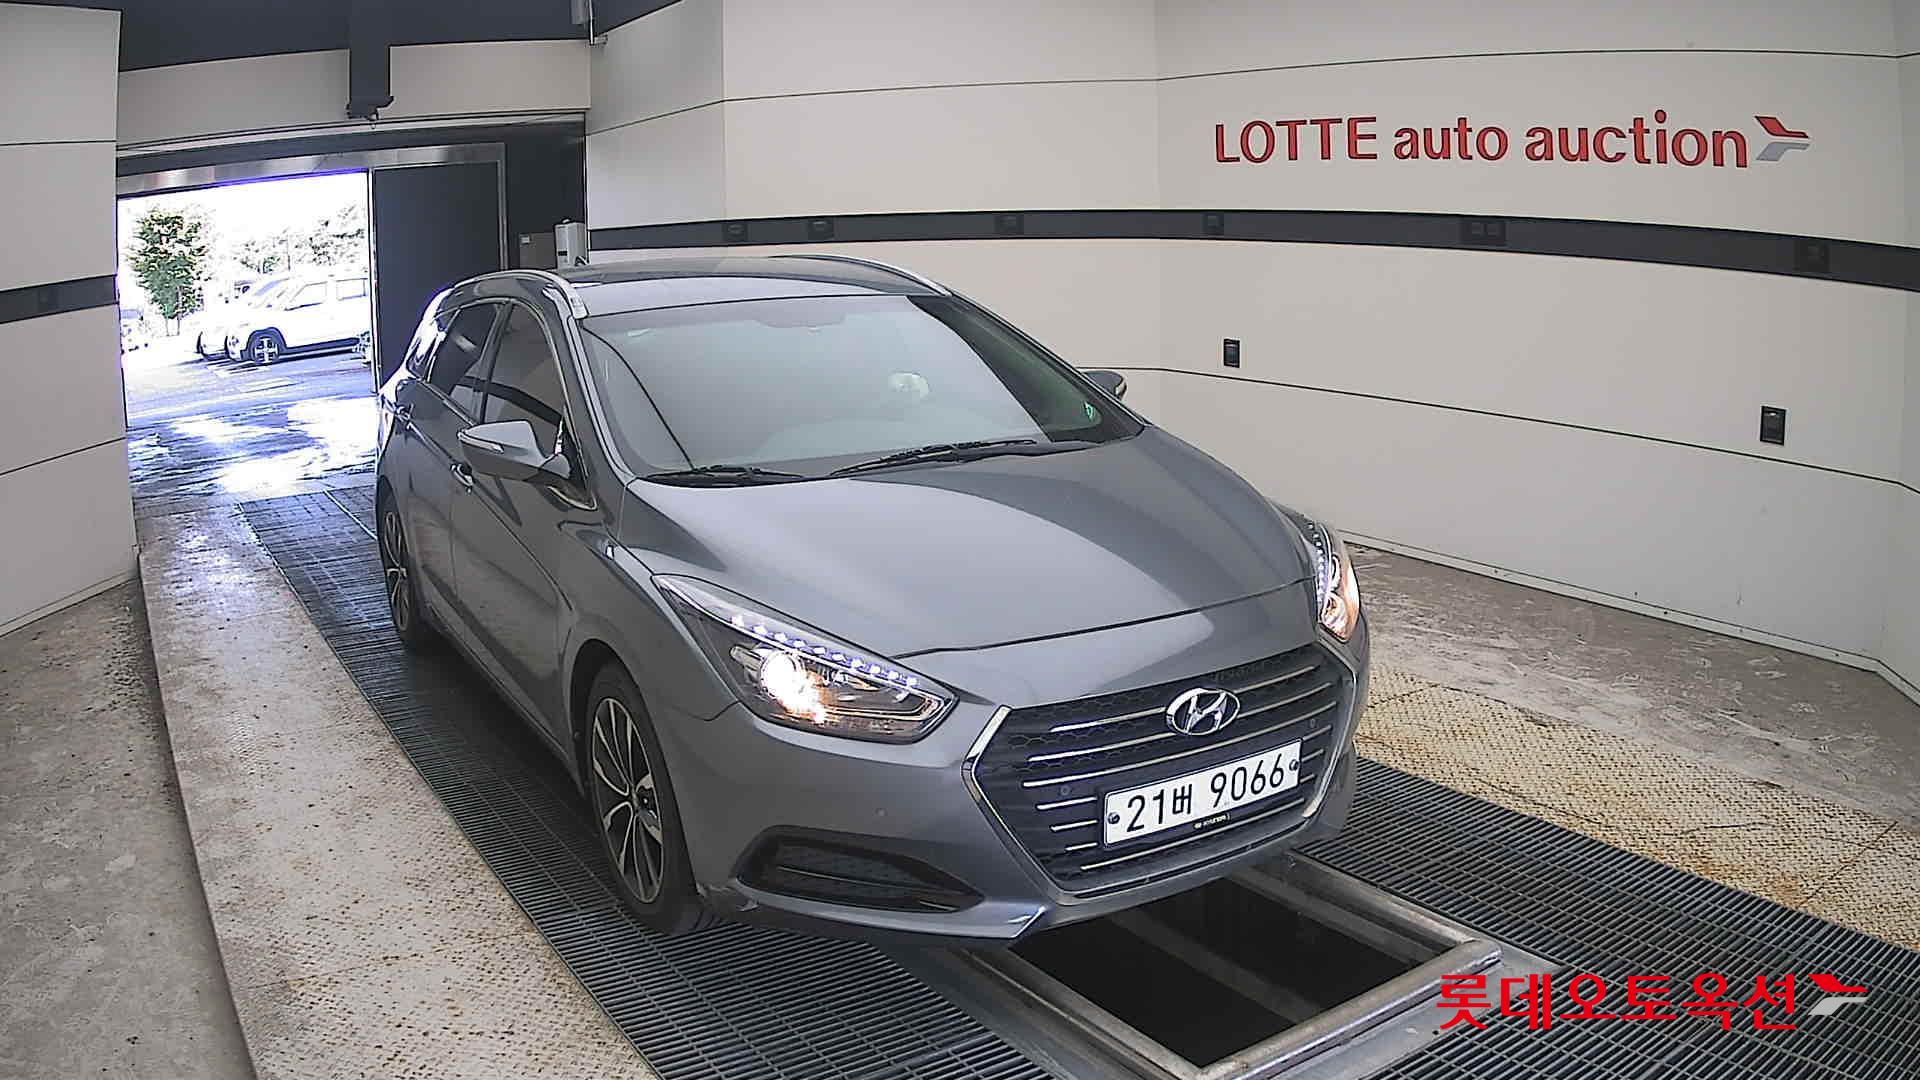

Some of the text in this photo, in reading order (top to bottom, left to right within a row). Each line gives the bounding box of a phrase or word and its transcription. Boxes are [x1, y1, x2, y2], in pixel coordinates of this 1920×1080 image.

[1215, 110, 1749, 169] LOTTE auto auction
[1126, 753, 1285, 833] 21버 9066
